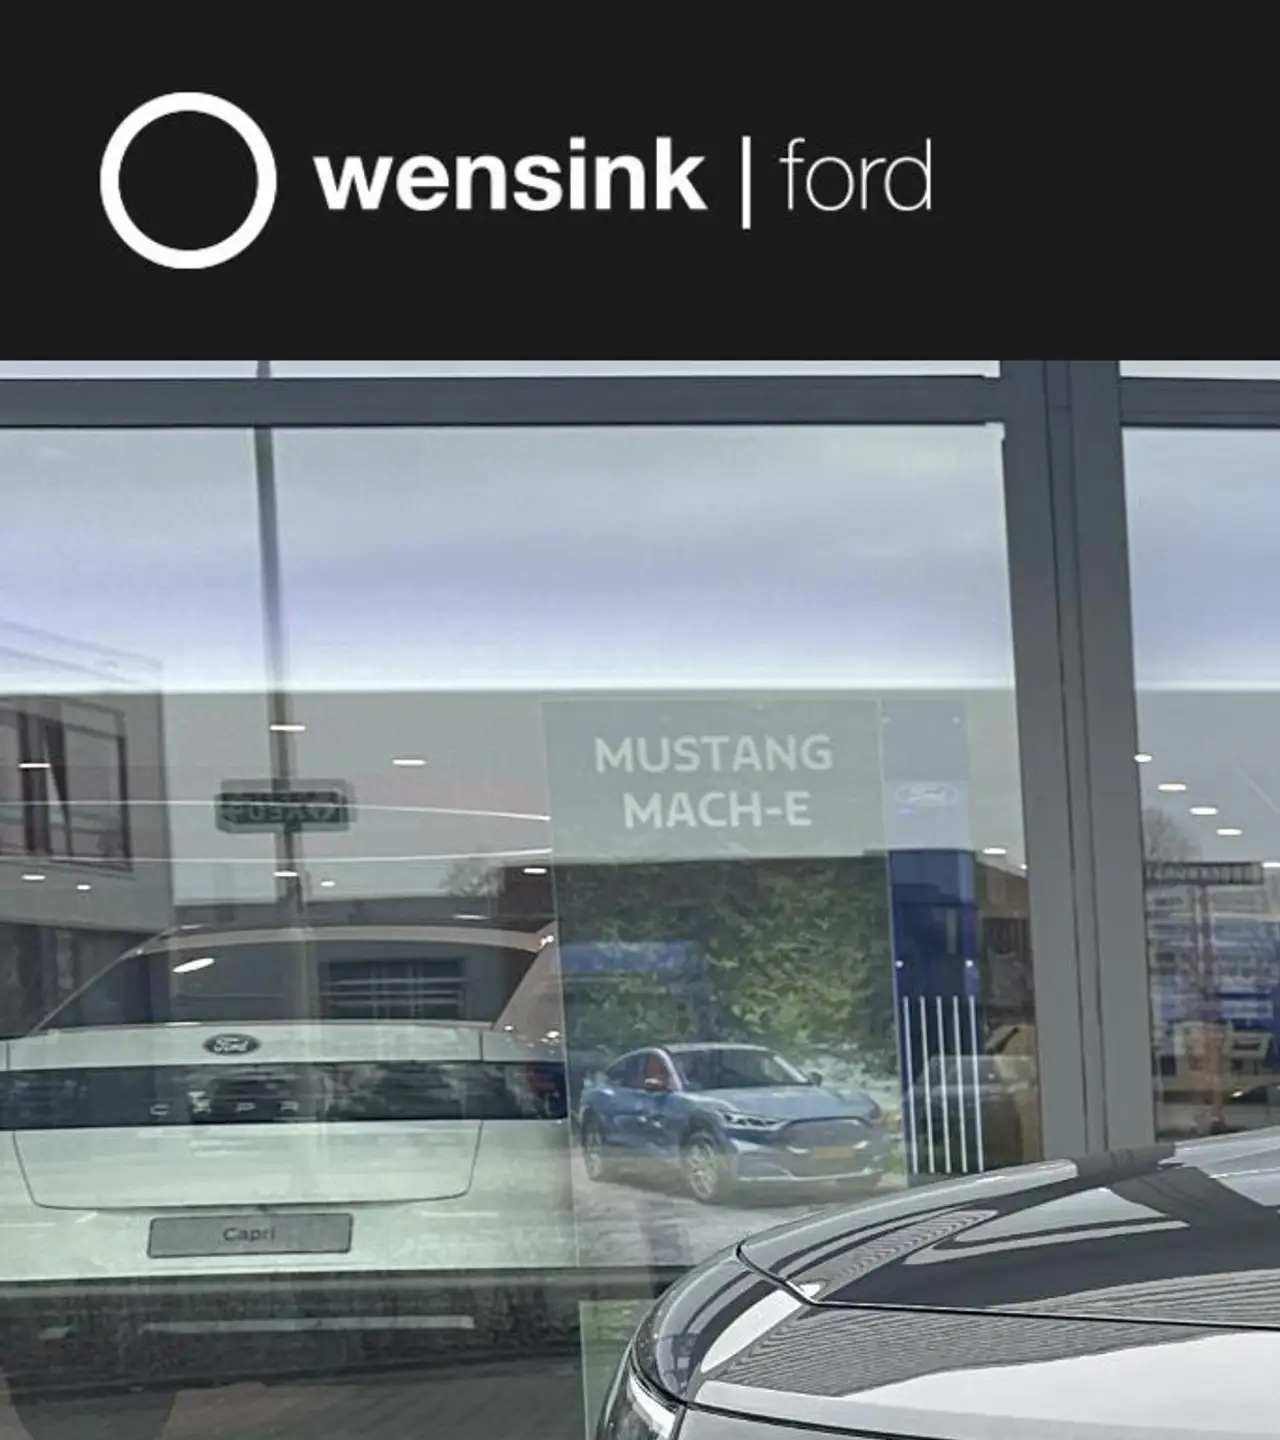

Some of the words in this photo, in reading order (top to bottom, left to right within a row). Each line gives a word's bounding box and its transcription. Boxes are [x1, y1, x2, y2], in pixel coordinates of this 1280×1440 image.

[594, 734, 832, 773] MUSTANG
[623, 790, 814, 829] MACH-E
[214, 1036, 249, 1052] Ford
[223, 1225, 276, 1243] Capri
